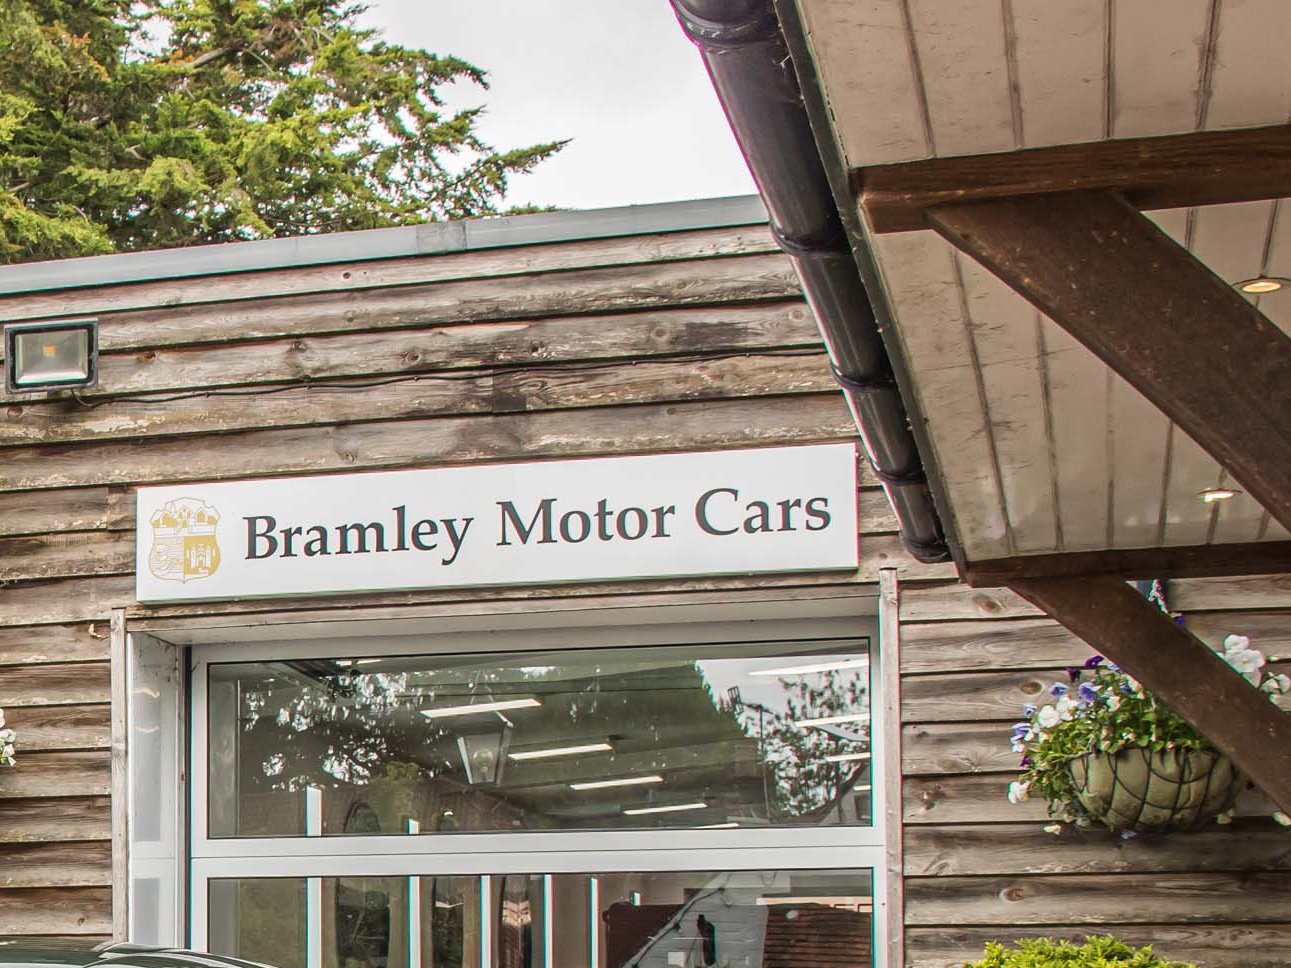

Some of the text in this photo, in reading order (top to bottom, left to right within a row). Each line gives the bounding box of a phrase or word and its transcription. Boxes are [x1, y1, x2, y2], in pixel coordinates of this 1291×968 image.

[242, 487, 832, 566] Bramley Motor Cars
